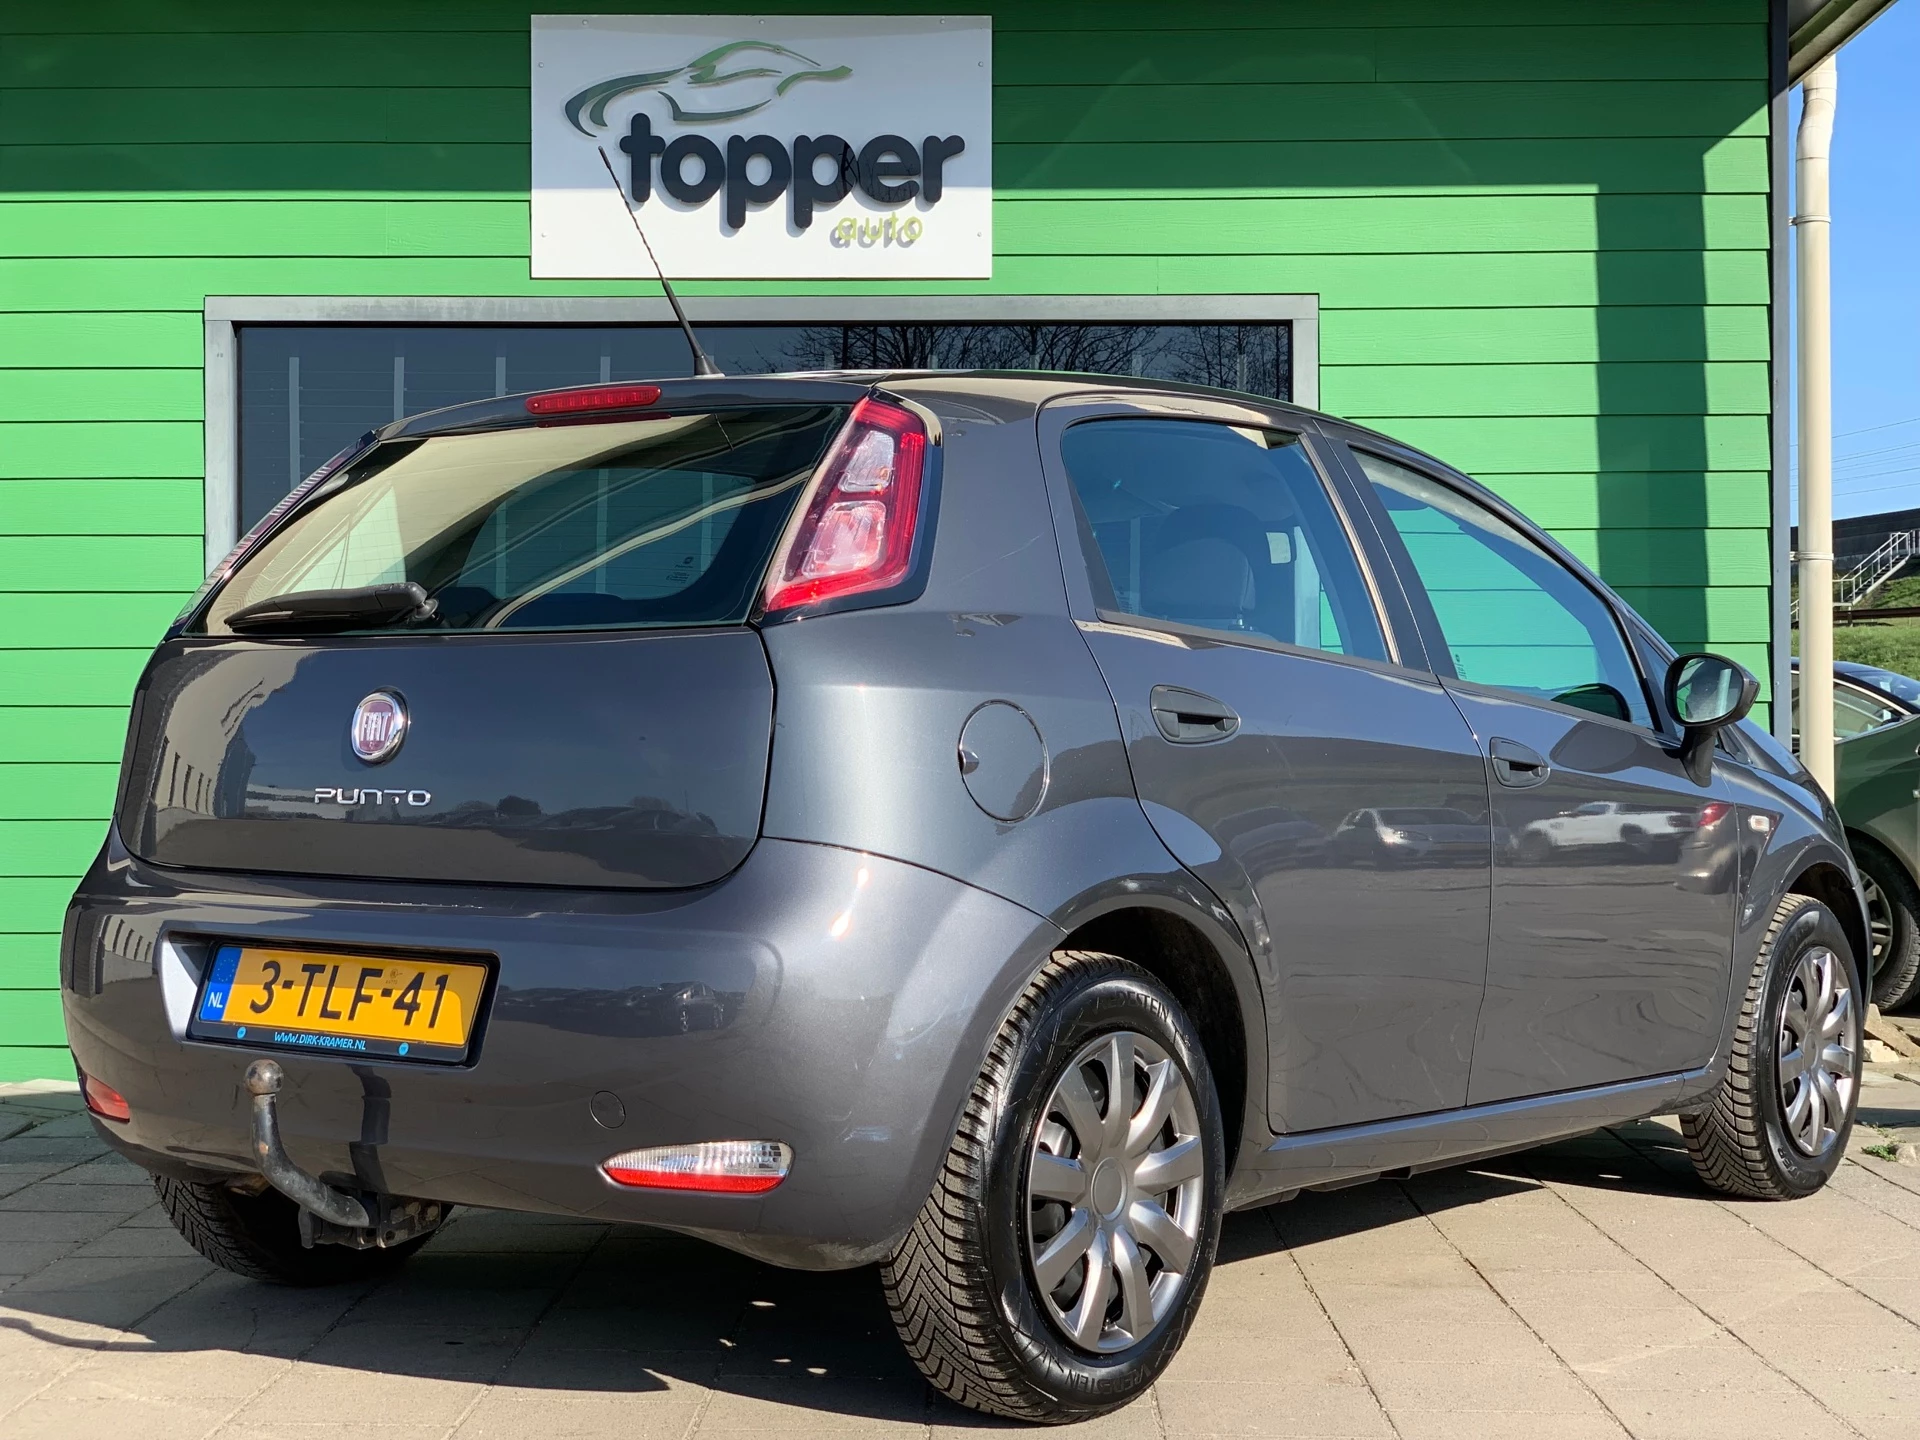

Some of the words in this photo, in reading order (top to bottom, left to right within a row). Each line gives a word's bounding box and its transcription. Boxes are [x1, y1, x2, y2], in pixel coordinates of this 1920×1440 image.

[619, 113, 965, 229] topper
[837, 212, 923, 241] auto
[360, 711, 391, 742] FIAT
[314, 787, 432, 806] PUNTO
[207, 991, 224, 1009] NL
[249, 960, 450, 1029] 3-TLF-41
[274, 1031, 366, 1050] WWW.DIRK-KRAMER.NL
